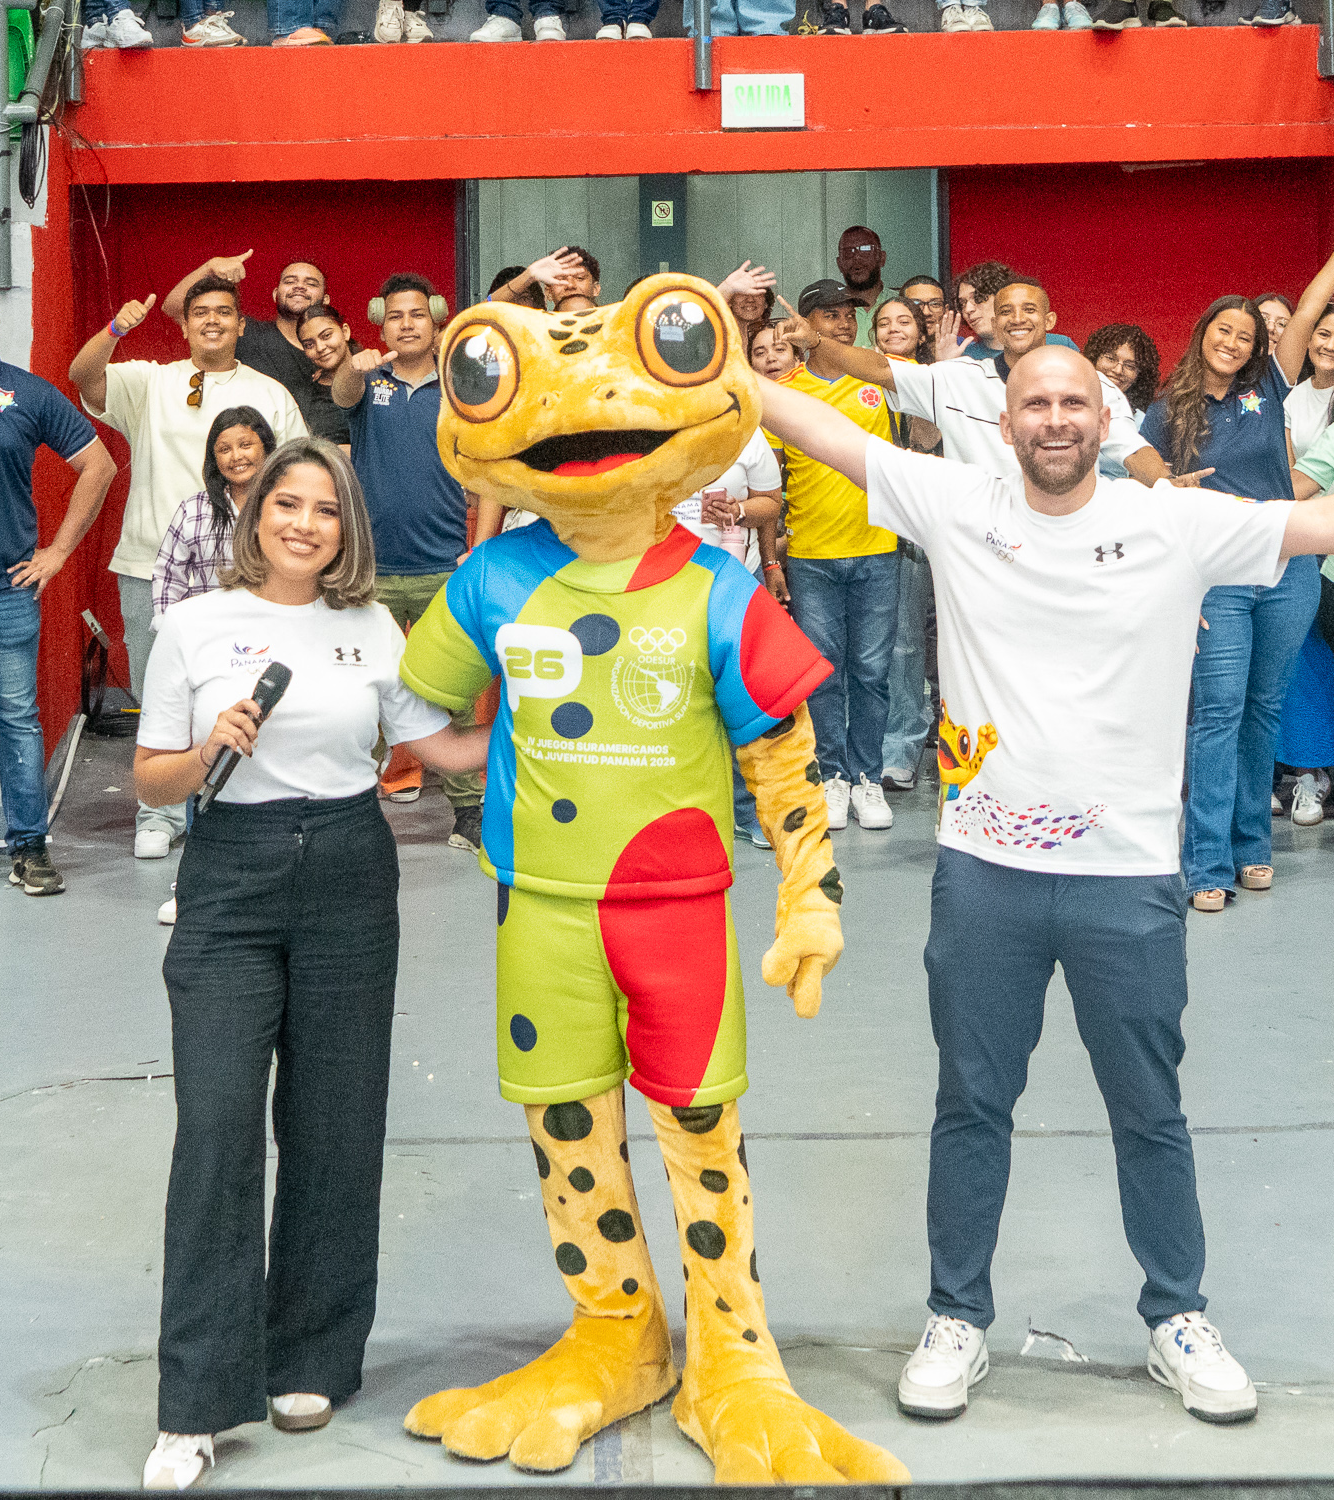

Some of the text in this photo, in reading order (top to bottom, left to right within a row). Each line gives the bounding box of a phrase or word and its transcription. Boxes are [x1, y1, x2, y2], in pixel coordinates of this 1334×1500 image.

[734, 85, 793, 116] SALIDA
[504, 647, 565, 680] 26
[638, 655, 676, 665] ODESUR
[631, 716, 675, 730] DEPORTIVA
[527, 736, 669, 754] IV JUEGOS SURAMERICANOS
[531, 749, 543, 760] LA
[545, 751, 599, 765] JUVENTUD
[600, 754, 648, 767] PANAMÁ
[650, 756, 676, 767] 2026
